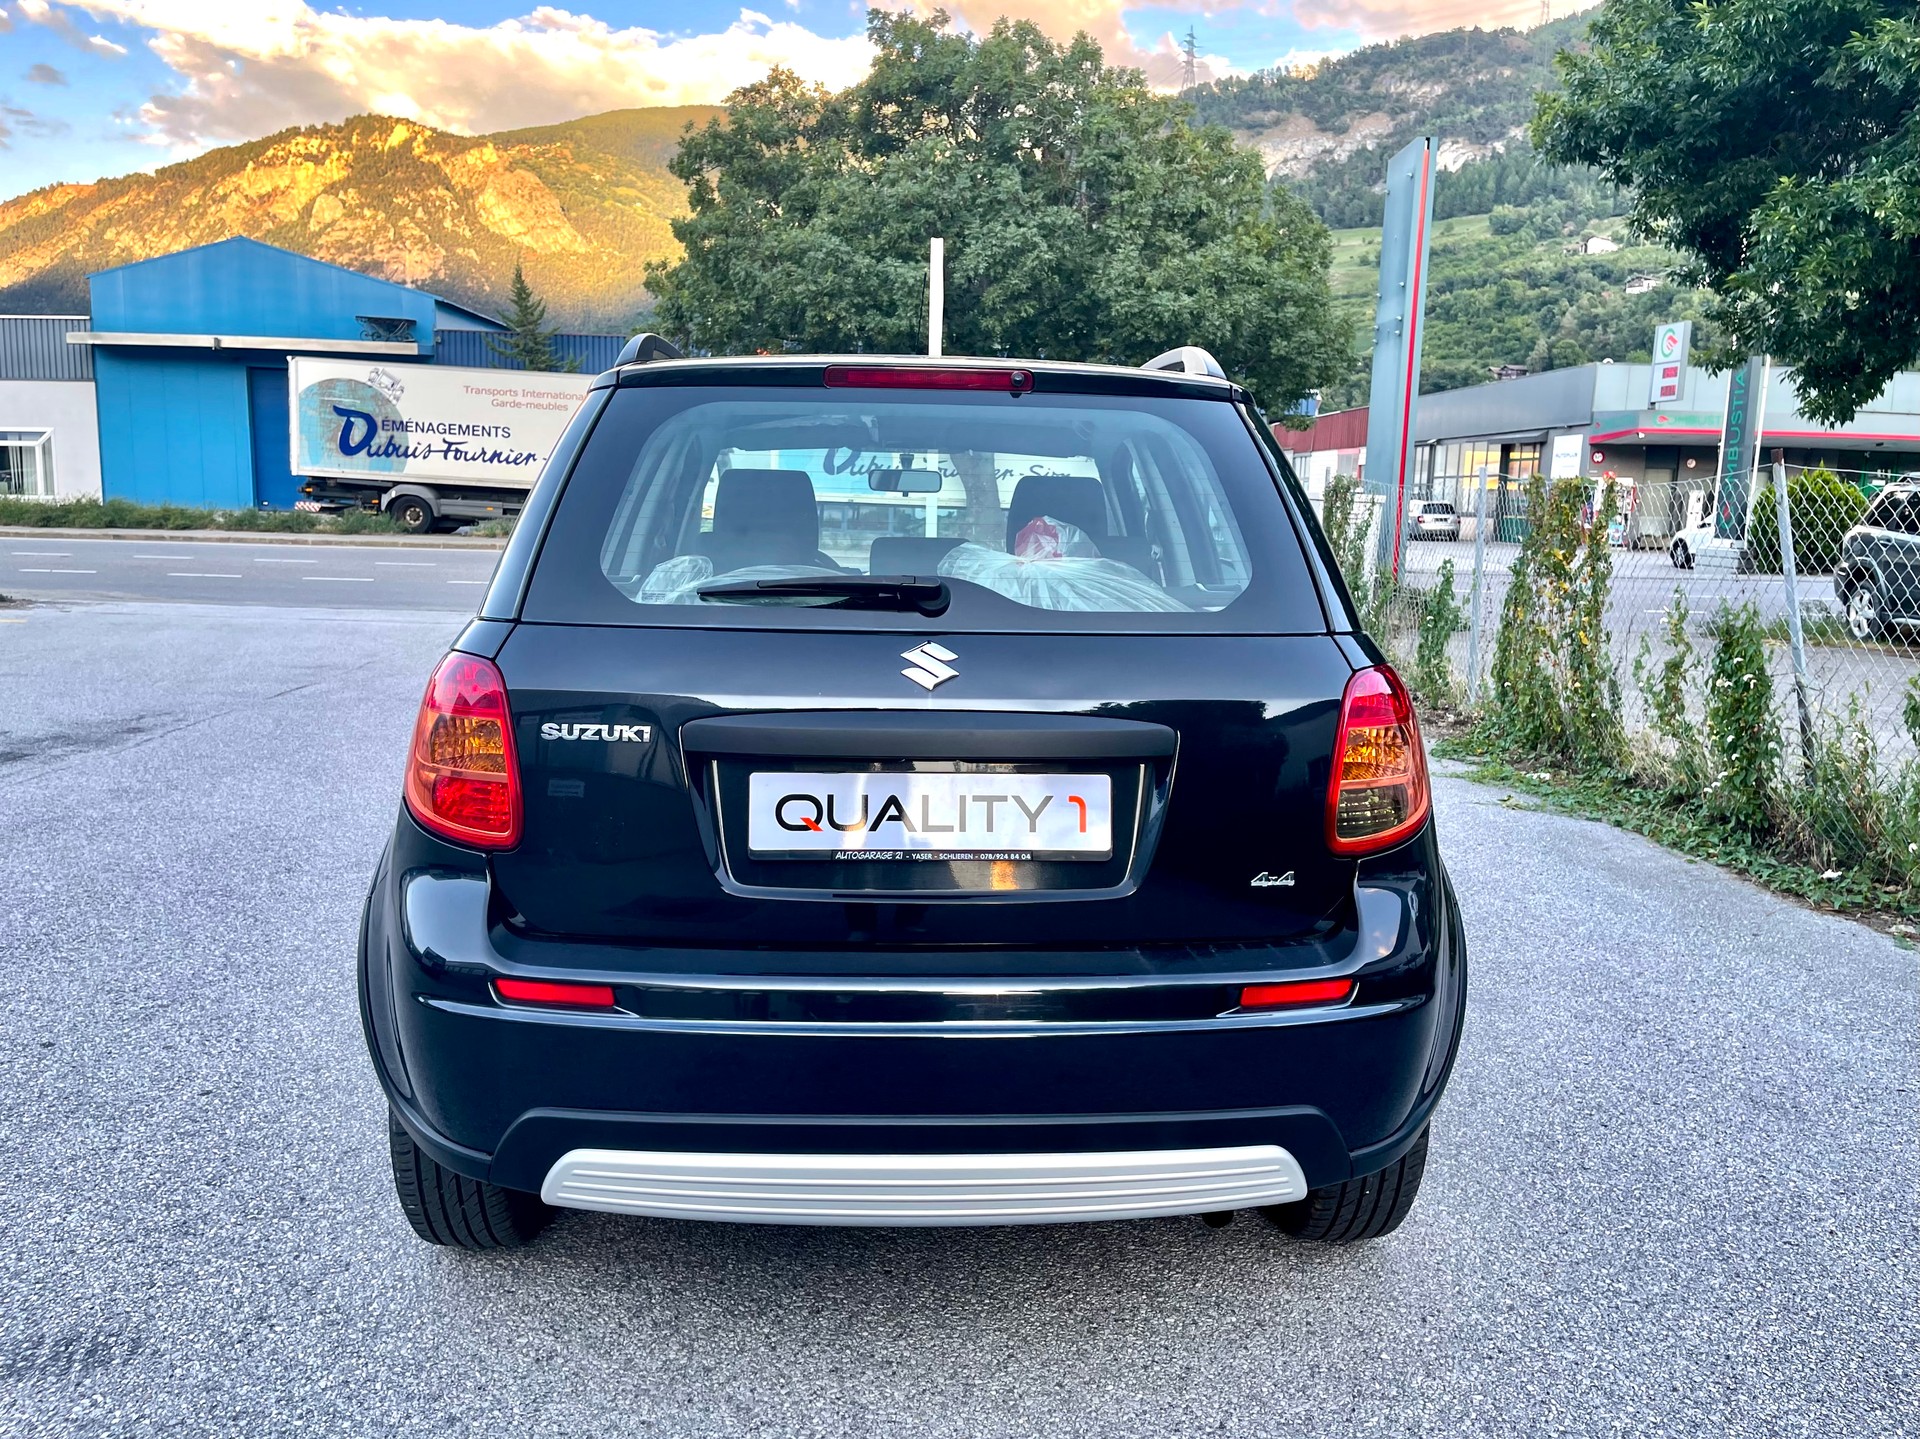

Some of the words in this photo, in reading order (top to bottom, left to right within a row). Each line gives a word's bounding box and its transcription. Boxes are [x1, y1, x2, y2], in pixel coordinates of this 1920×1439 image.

[463, 385, 518, 398] Transports
[521, 389, 587, 402] Internationa
[491, 399, 569, 412] Garde-meubles
[442, 438, 538, 466] Fournier
[540, 722, 651, 743] SUZUKI
[775, 794, 1054, 832] QUALITY
[1068, 795, 1087, 832] 1
[836, 851, 893, 860] AUTOGARAGE
[895, 851, 903, 860] 21
[1251, 871, 1295, 887] 4x4
